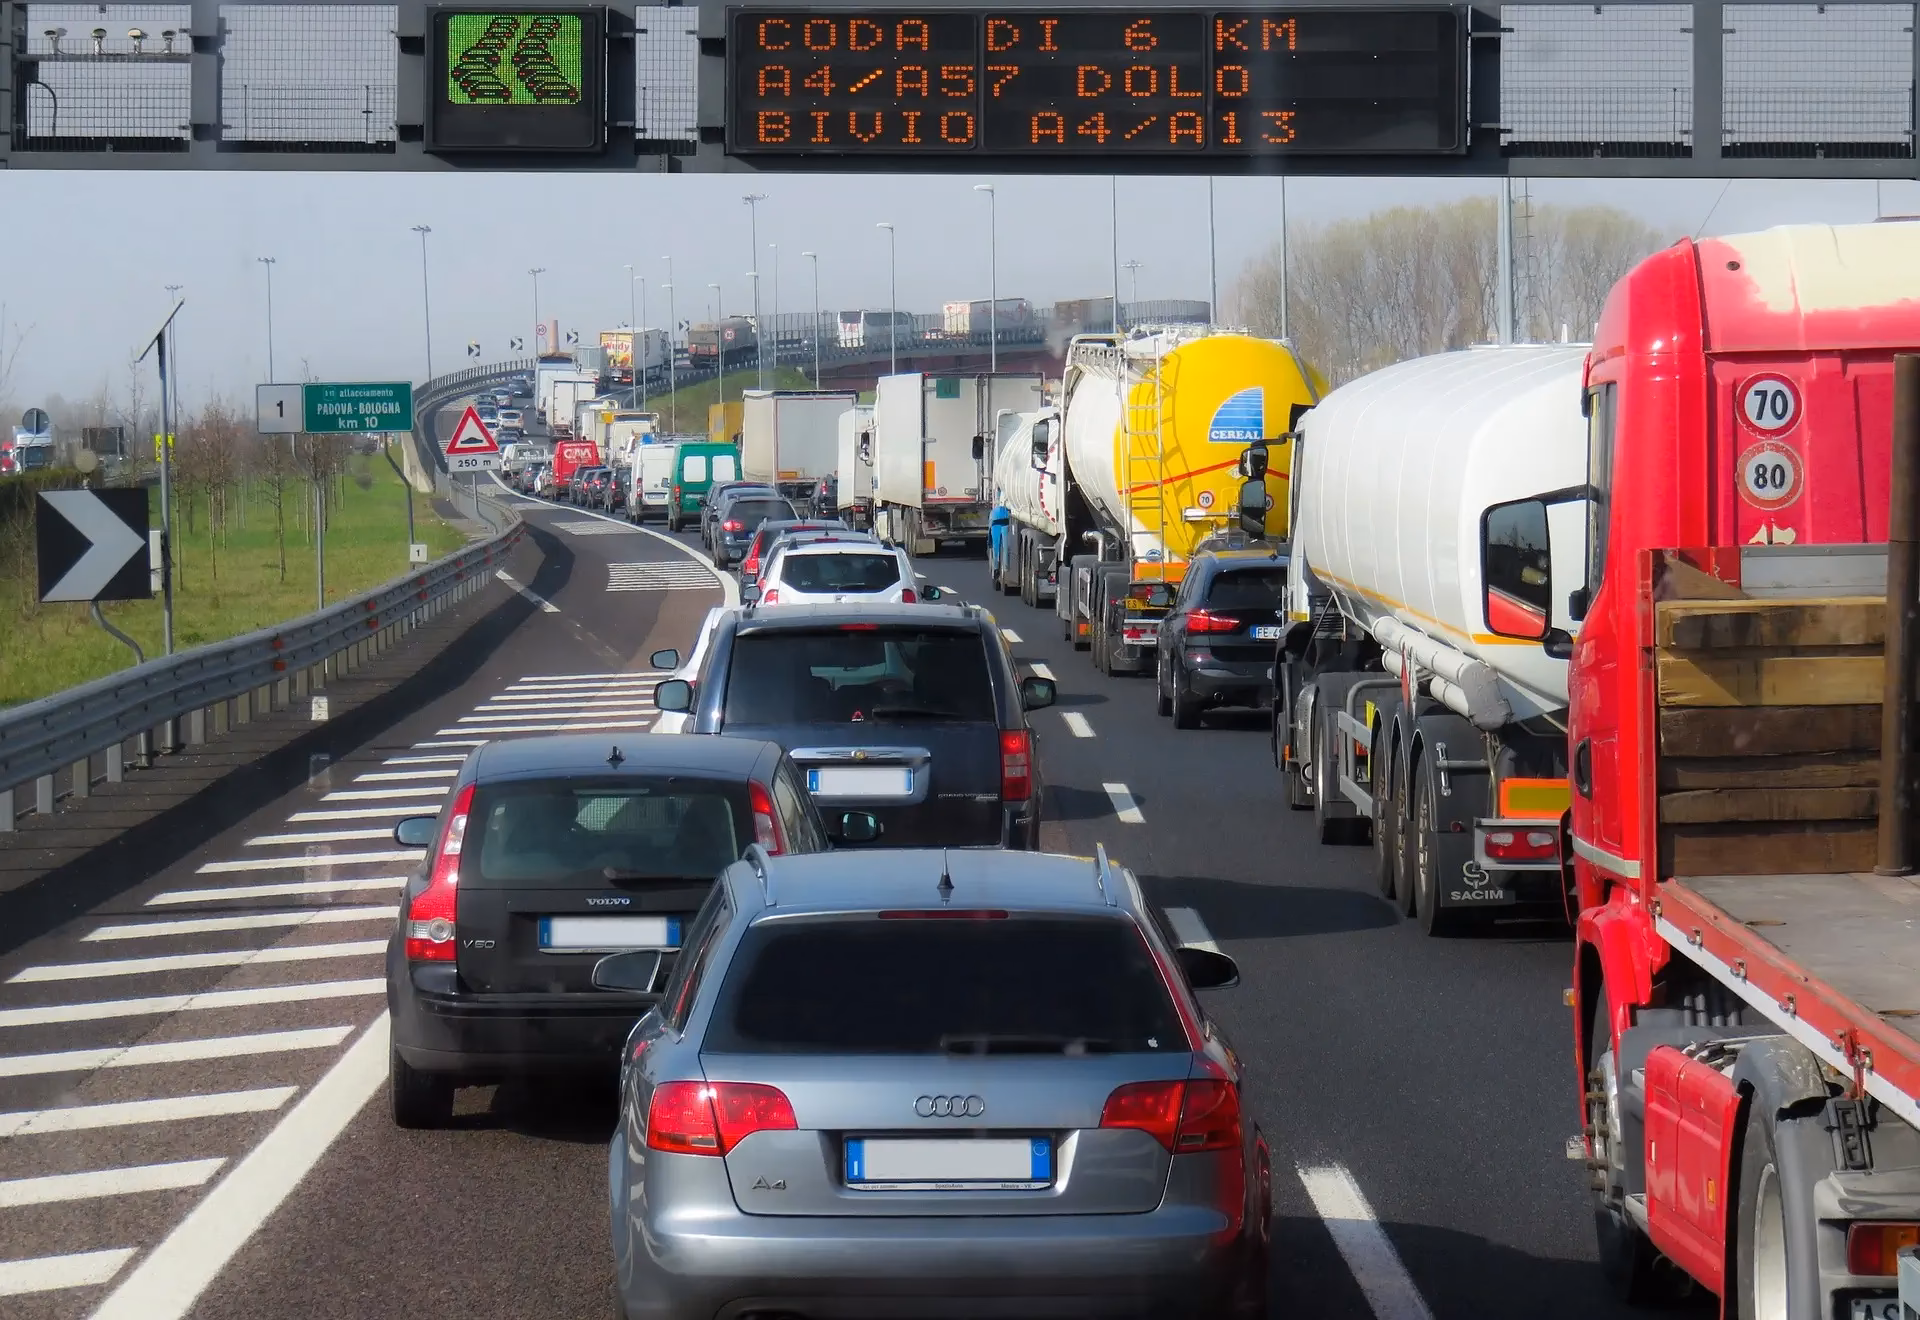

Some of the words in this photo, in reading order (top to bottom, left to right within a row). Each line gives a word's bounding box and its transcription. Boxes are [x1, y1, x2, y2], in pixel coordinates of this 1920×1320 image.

[757, 19, 929, 51] CODA
[987, 19, 1059, 51] DI
[1124, 19, 1158, 51] 6
[1215, 19, 1296, 51] KM
[757, 65, 1019, 97] A4/A57
[1076, 65, 1249, 97] DOLO
[757, 111, 974, 143] BIVIO
[1030, 111, 1296, 143] A4/A13
[339, 388, 394, 398] allacciamento
[276, 400, 283, 418] 1
[1753, 389, 1788, 420] 70
[338, 417, 359, 429] km
[364, 416, 379, 429] 10
[1211, 430, 1260, 440] CEREAL
[458, 459, 478, 468] 250
[1753, 463, 1786, 490] 80
[1201, 496, 1210, 504] 70
[1450, 889, 1504, 901] SACIM
[463, 939, 496, 949] V50
[752, 1175, 787, 1191] A4
